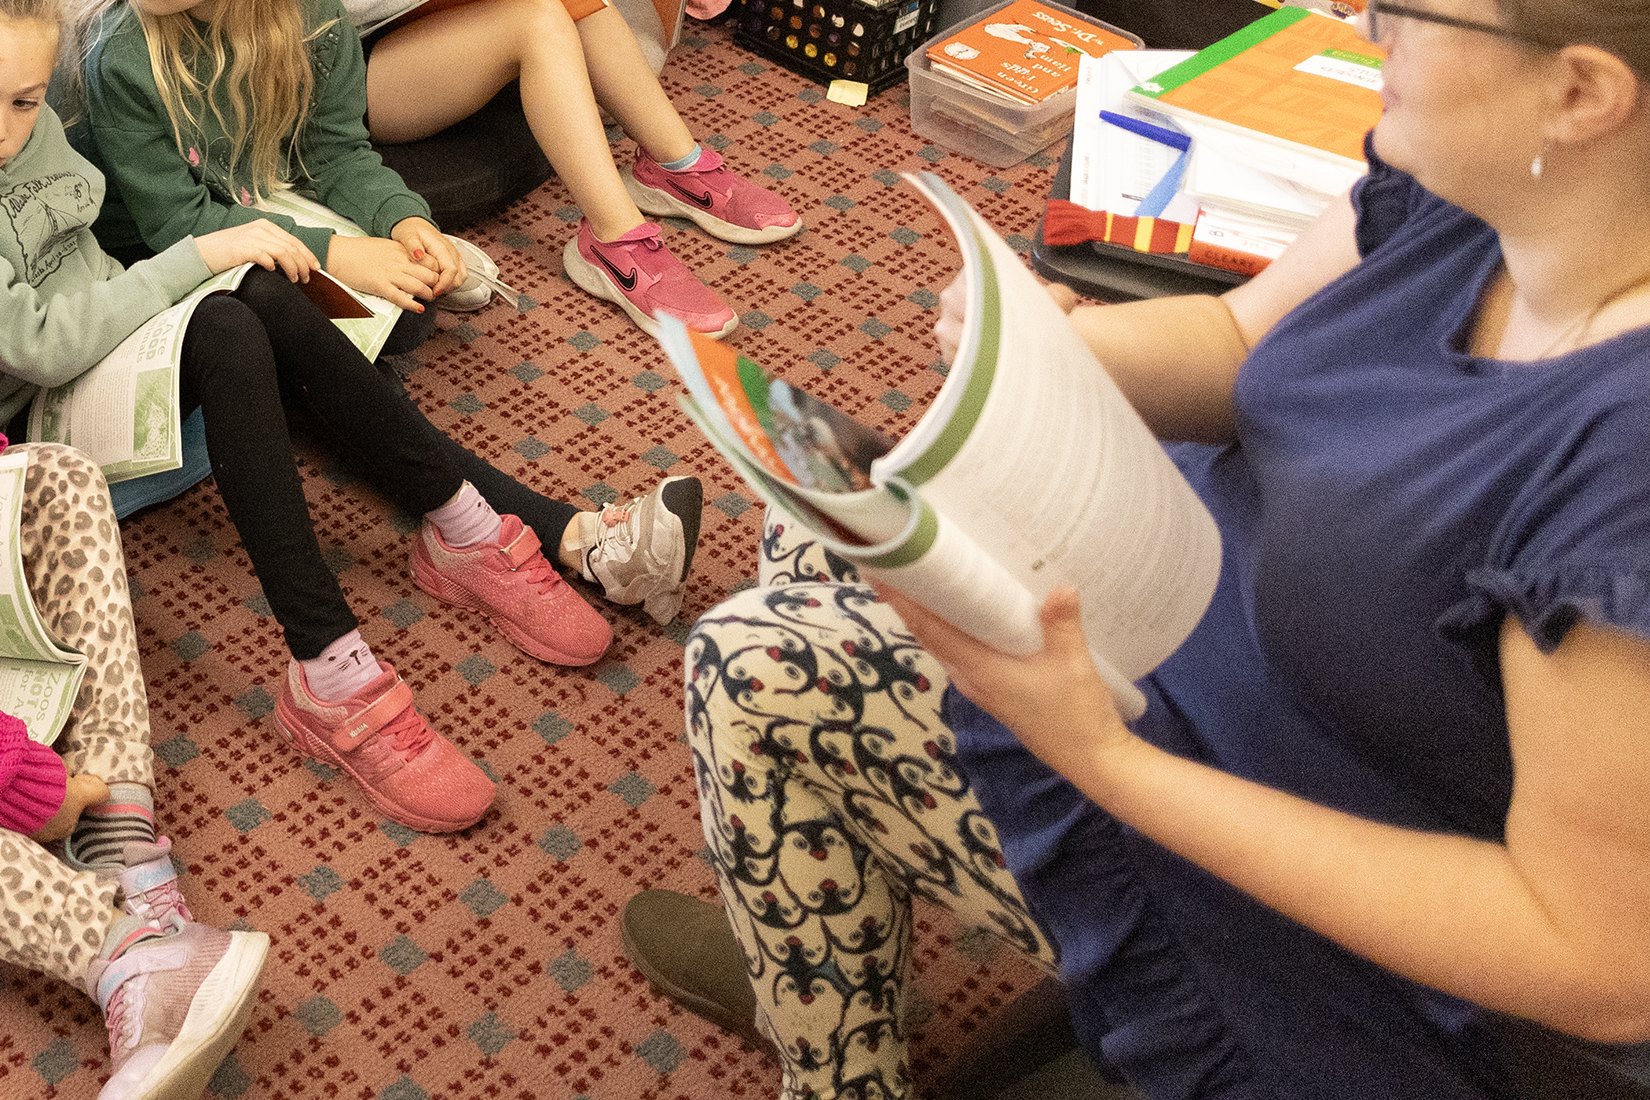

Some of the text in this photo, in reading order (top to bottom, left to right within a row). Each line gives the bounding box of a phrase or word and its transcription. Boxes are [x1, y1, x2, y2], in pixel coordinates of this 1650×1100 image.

[1032, 11, 1072, 32] Seuss
[1000, 62, 1036, 81] Eggs
[1032, 63, 1061, 78] and
[1040, 55, 1071, 72] Ham
[997, 71, 1039, 94] Green
[20, 669, 33, 691] for
[27, 669, 48, 709] NOT
[36, 672, 61, 721] Zoos
